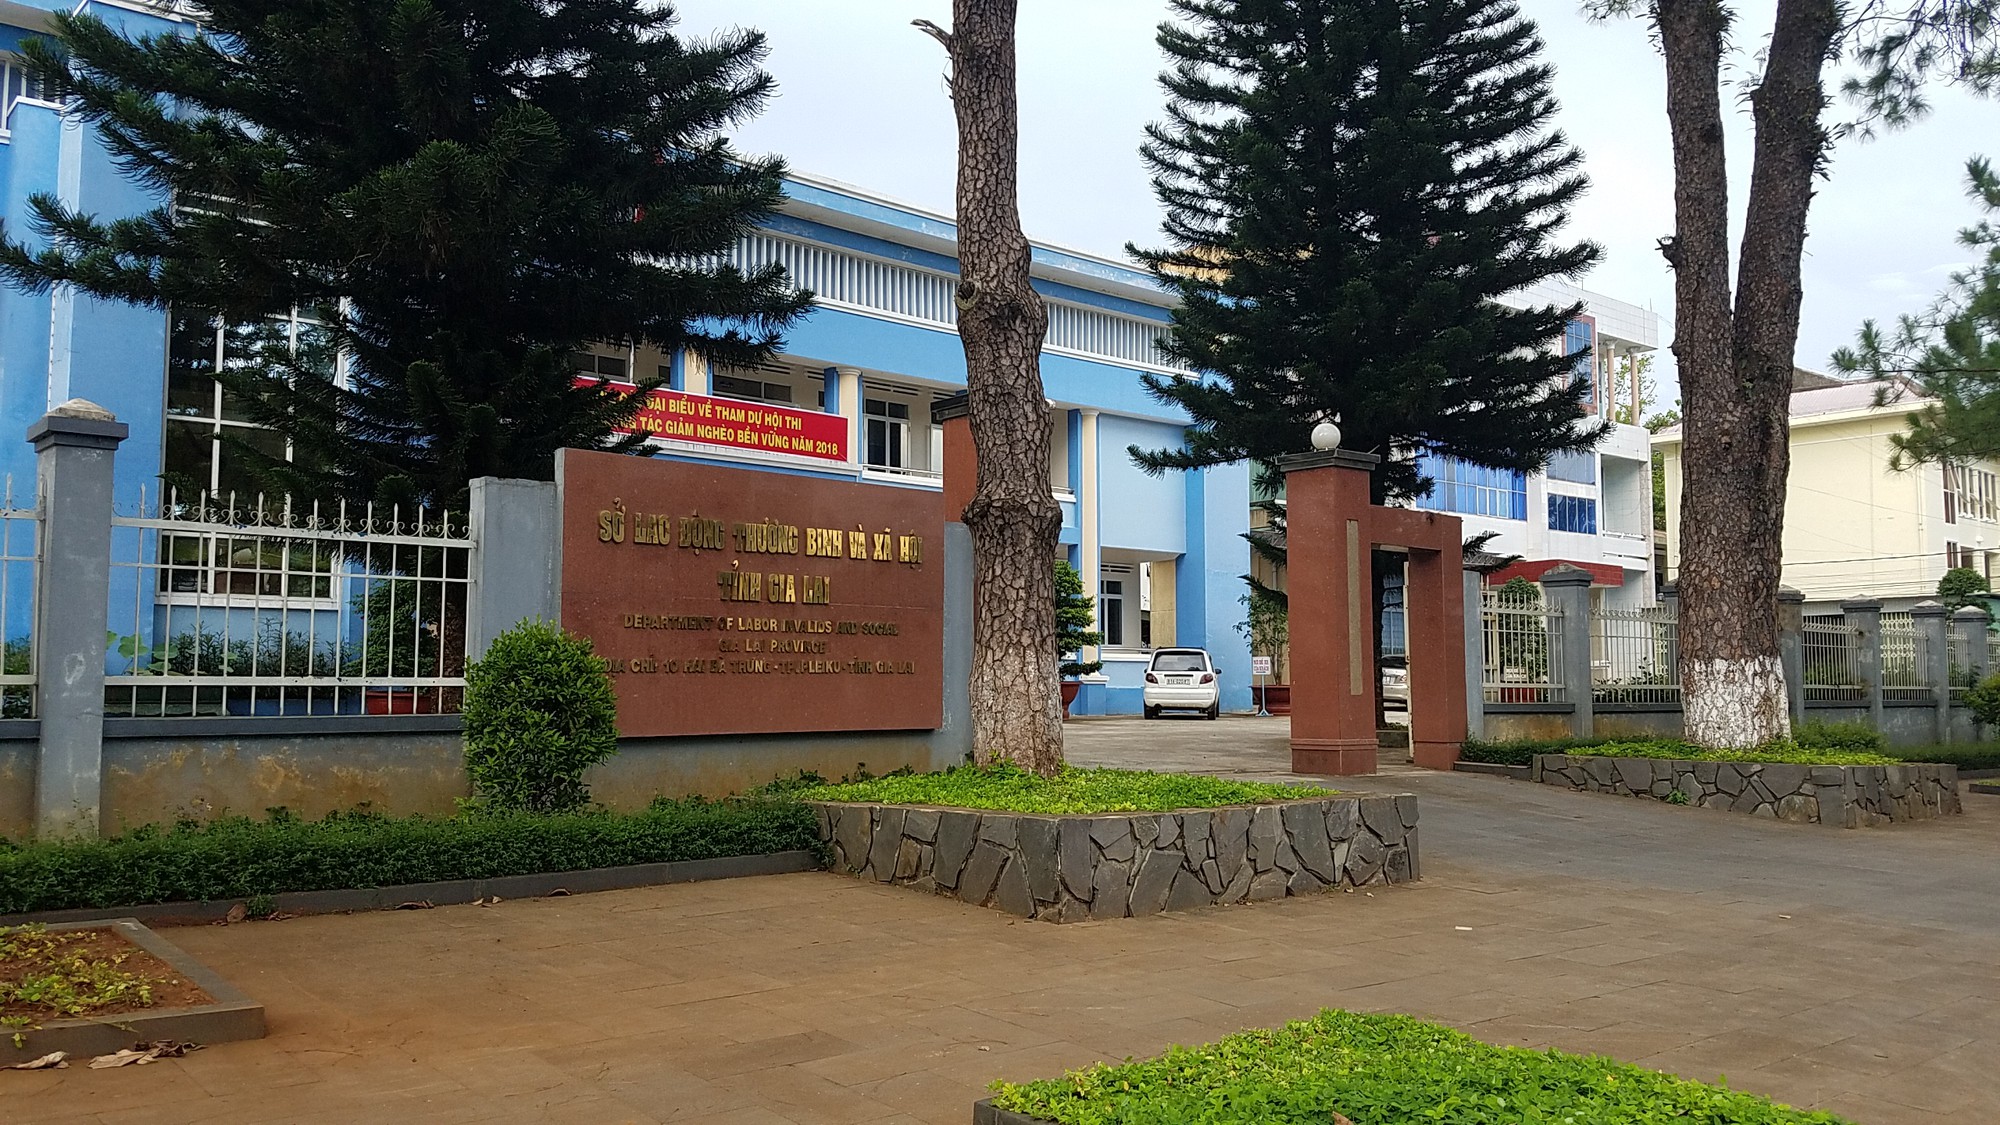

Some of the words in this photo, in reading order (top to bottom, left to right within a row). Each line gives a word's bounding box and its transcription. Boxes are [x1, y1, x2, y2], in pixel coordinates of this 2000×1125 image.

[669, 395, 695, 416] BIỂU
[698, 399, 713, 418] VỀ
[715, 405, 745, 422] THAM
[748, 410, 762, 428] DỰ
[764, 412, 782, 430] HỘI
[785, 416, 802, 431] THI
[640, 414, 663, 433] TÁC
[666, 417, 694, 437] GIẢM
[697, 424, 735, 442] NGHÈO
[737, 426, 759, 445] BỀN
[761, 430, 789, 449] VỮNG
[792, 435, 814, 452] NĂM
[816, 441, 838, 455] 2018
[599, 497, 626, 543] SỞ
[634, 512, 671, 546] LAO
[679, 509, 725, 556] ĐỘNG
[732, 517, 799, 554] THƯƠNG
[806, 527, 843, 558] BINH
[849, 523, 867, 560] VÀ
[873, 527, 893, 562] XÃ
[899, 529, 923, 569] HỘI
[718, 559, 762, 603] TỈNH
[768, 573, 796, 604] GIA
[802, 575, 831, 605] LAI
[623, 614, 713, 631] DEPARTMENT
[717, 617, 734, 632] OF
[738, 617, 778, 633] LABOR
[781, 619, 833, 635] INVALIDS
[836, 621, 858, 635] AND
[861, 621, 899, 637] SOCIAL
[719, 638, 740, 653] GIA
[745, 639, 766, 654] LAI
[770, 639, 827, 655] PROVINCE
[875, 660, 894, 674] GIA
[897, 661, 915, 674] LAI
